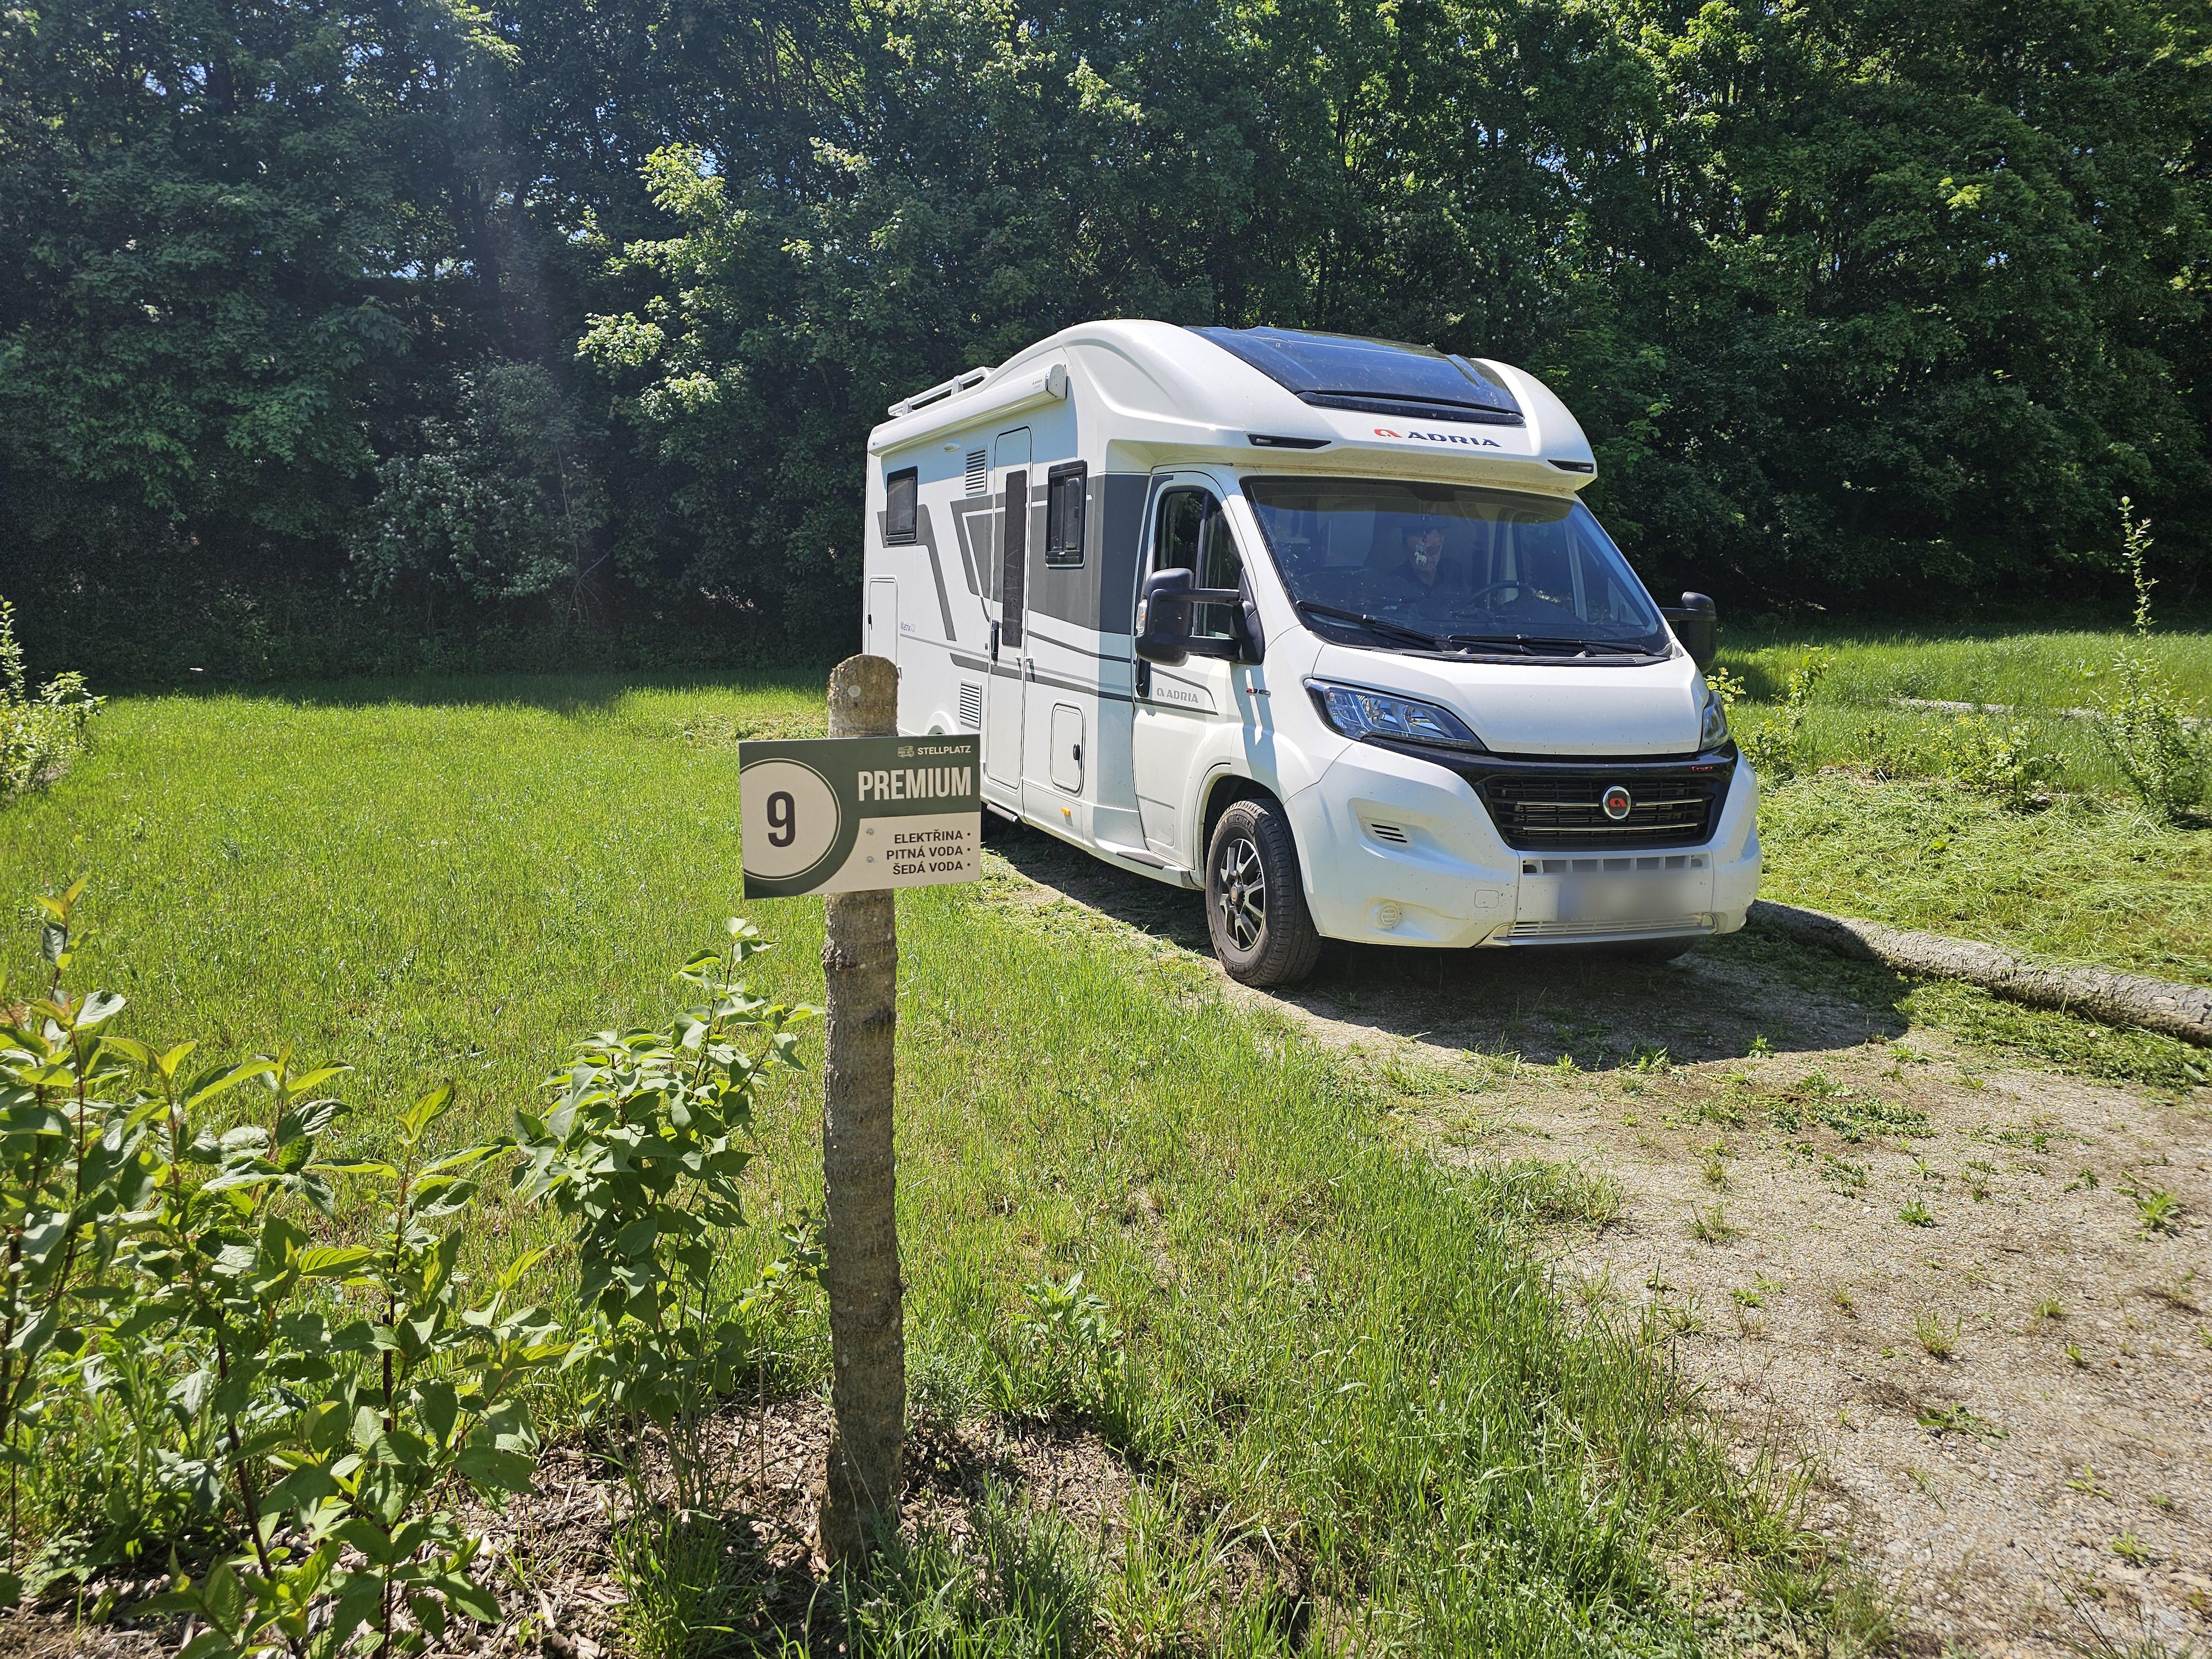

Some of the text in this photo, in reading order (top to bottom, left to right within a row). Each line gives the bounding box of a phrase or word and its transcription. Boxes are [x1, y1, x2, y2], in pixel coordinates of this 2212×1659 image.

[1408, 431, 1502, 447] ADRIA
[1166, 689, 1198, 703] ADRIA
[917, 745, 971, 755] STELLPLATZ
[858, 766, 971, 801] PREMIUM
[766, 791, 796, 847] 9
[894, 829, 963, 844] ELEKTŘINA
[886, 846, 963, 860] PITNÁ VODA
[893, 861, 963, 875] ŠEDÁ VODA
